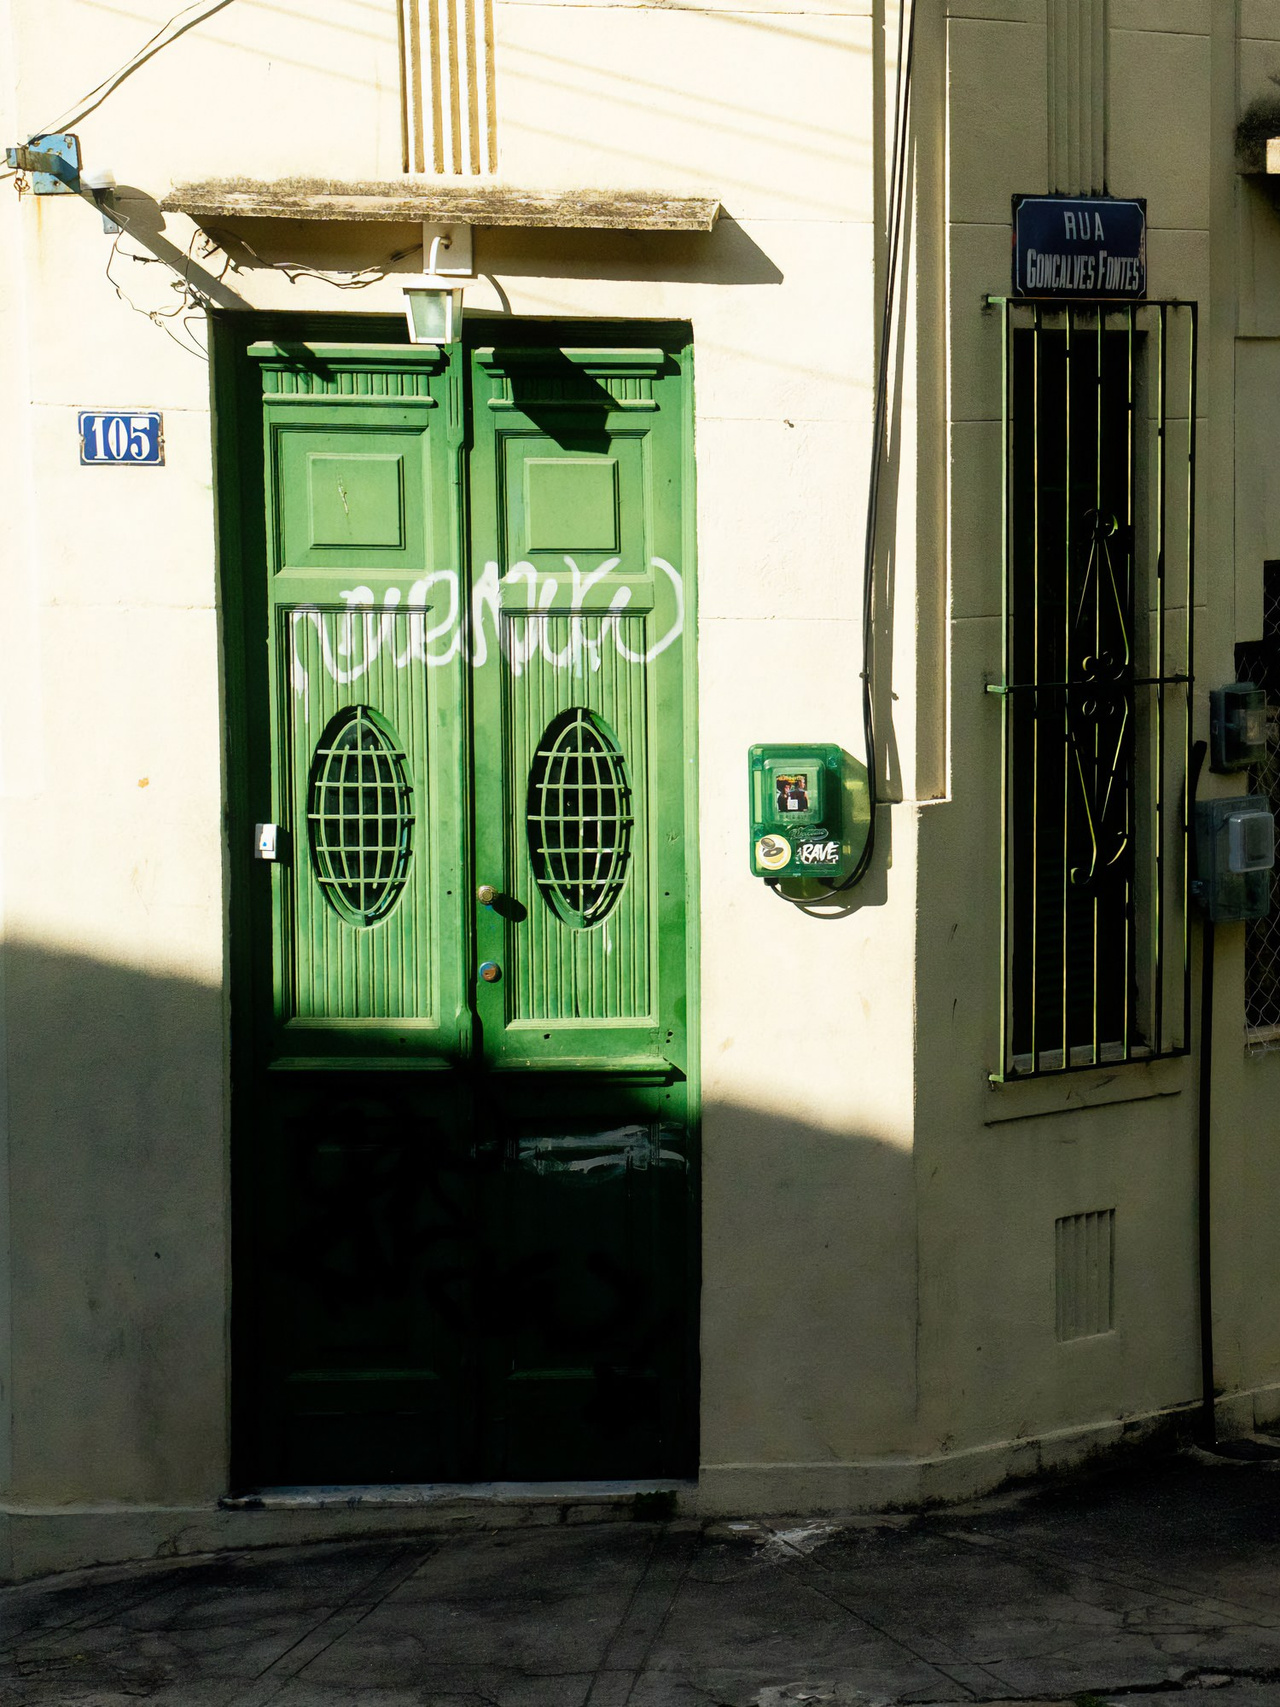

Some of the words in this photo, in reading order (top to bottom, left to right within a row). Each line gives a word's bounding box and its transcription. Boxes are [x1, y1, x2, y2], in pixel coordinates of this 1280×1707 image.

[1063, 211, 1105, 241] RUA
[1026, 248, 1095, 291] GONÇALVES
[1096, 250, 1140, 291] FONTES
[91, 416, 151, 460] 105
